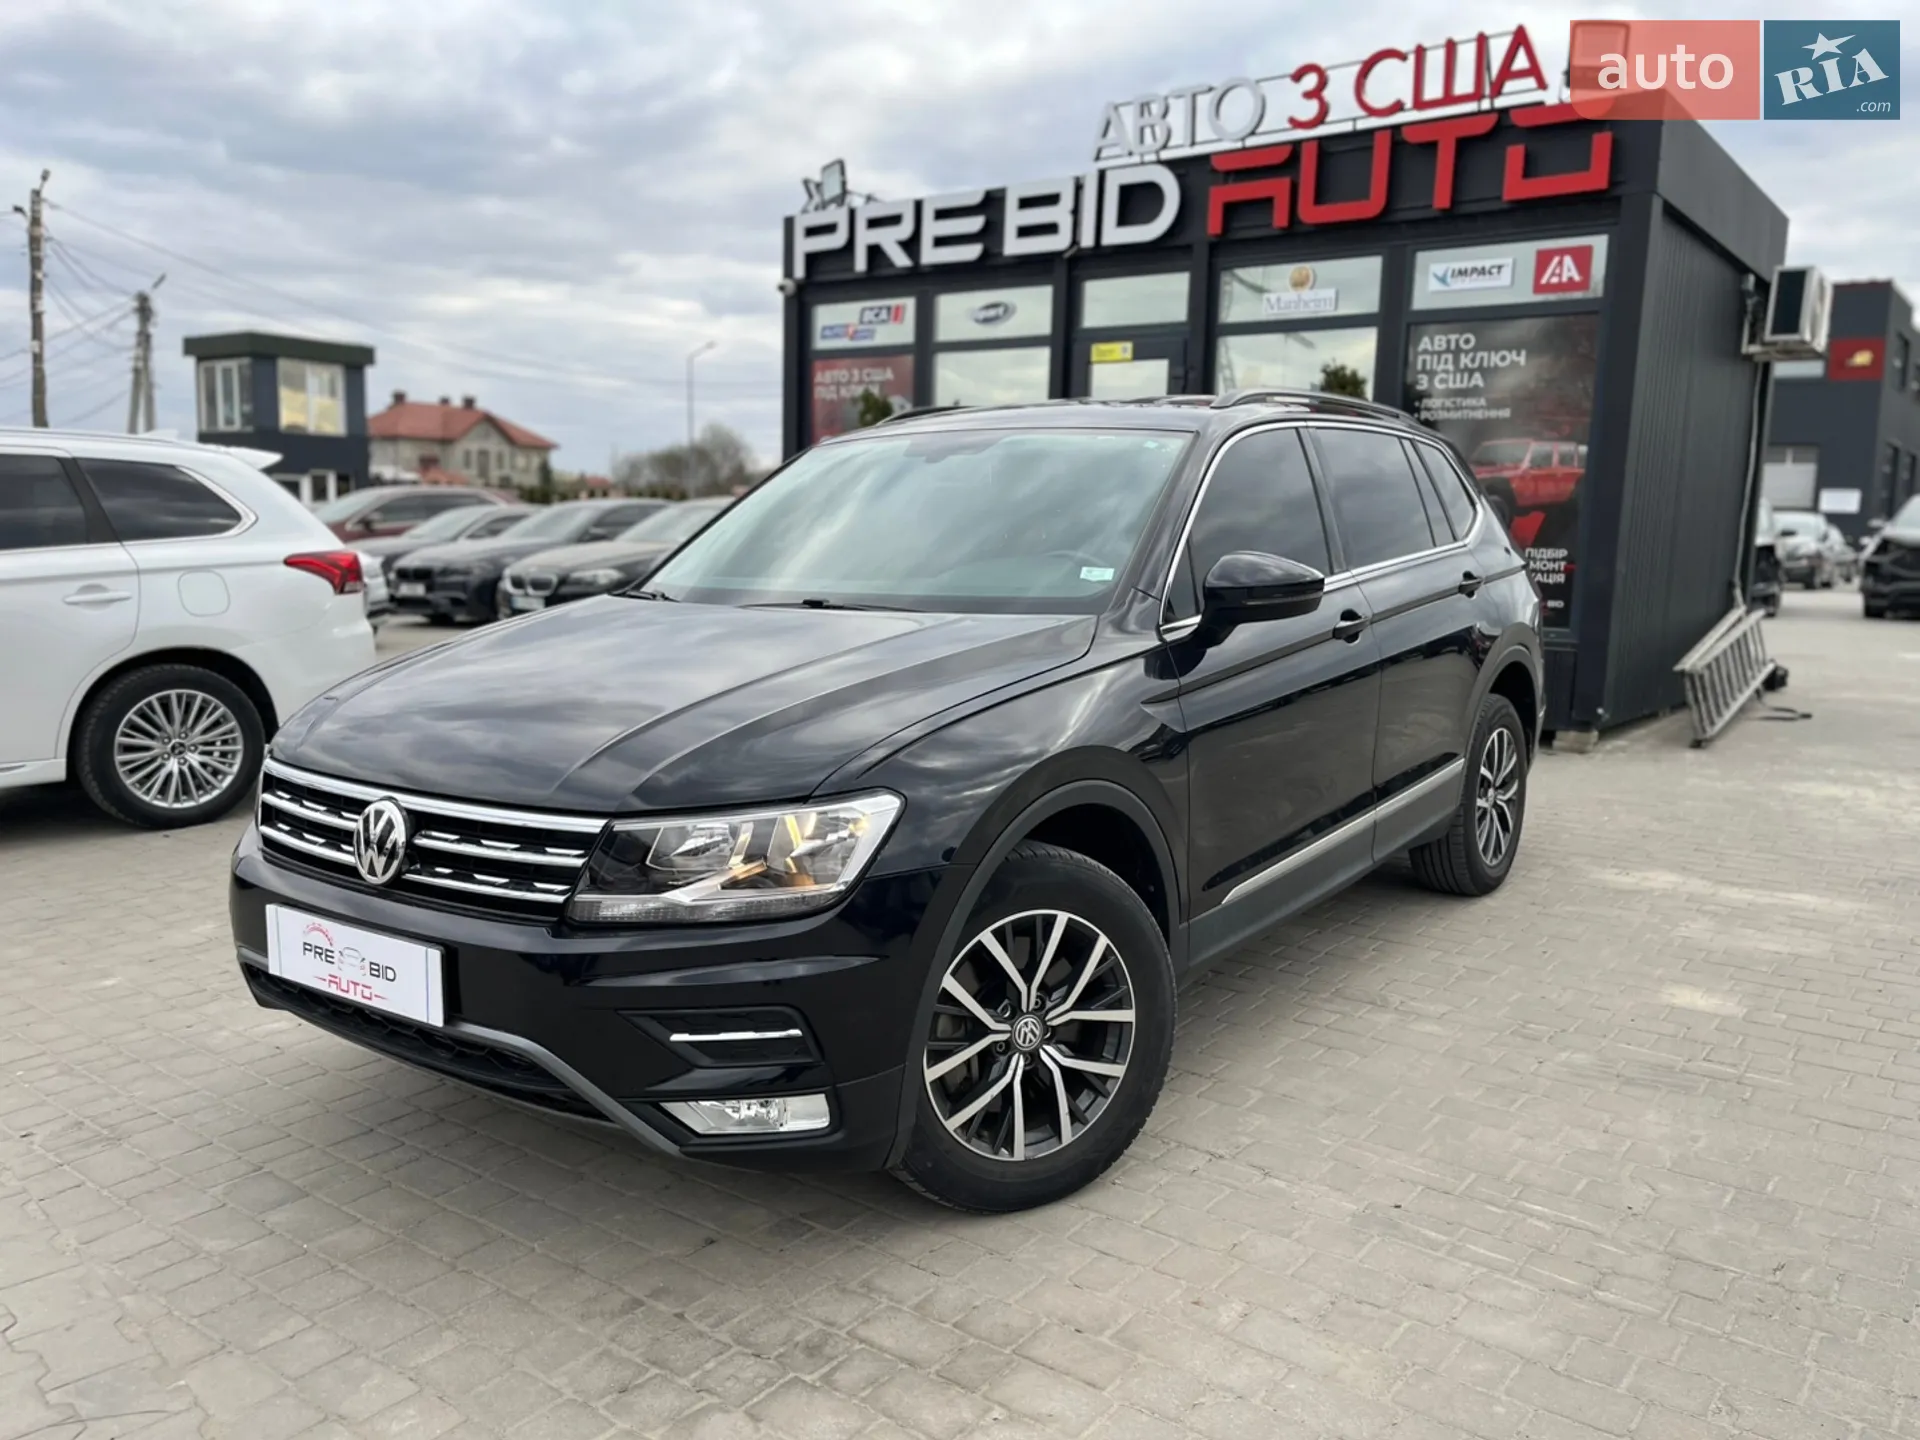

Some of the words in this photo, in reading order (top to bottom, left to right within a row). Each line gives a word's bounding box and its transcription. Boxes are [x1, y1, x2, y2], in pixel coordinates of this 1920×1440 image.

[1093, 75, 1267, 161] АВТО
[1353, 25, 1549, 119] США
[793, 189, 988, 279] PRE
[1003, 163, 1181, 257] BID
[1208, 98, 1613, 236] AUTO
[1450, 264, 1505, 279] IMPACT
[1418, 333, 1476, 351] АВТО
[1417, 353, 1454, 371] ПІД
[1460, 349, 1526, 369] КЛЮЧ
[1434, 371, 1484, 389] США
[1529, 560, 1566, 571] МОНТ
[303, 942, 335, 964] PRE
[369, 961, 396, 982] BID
[328, 973, 372, 1001] AUTO
